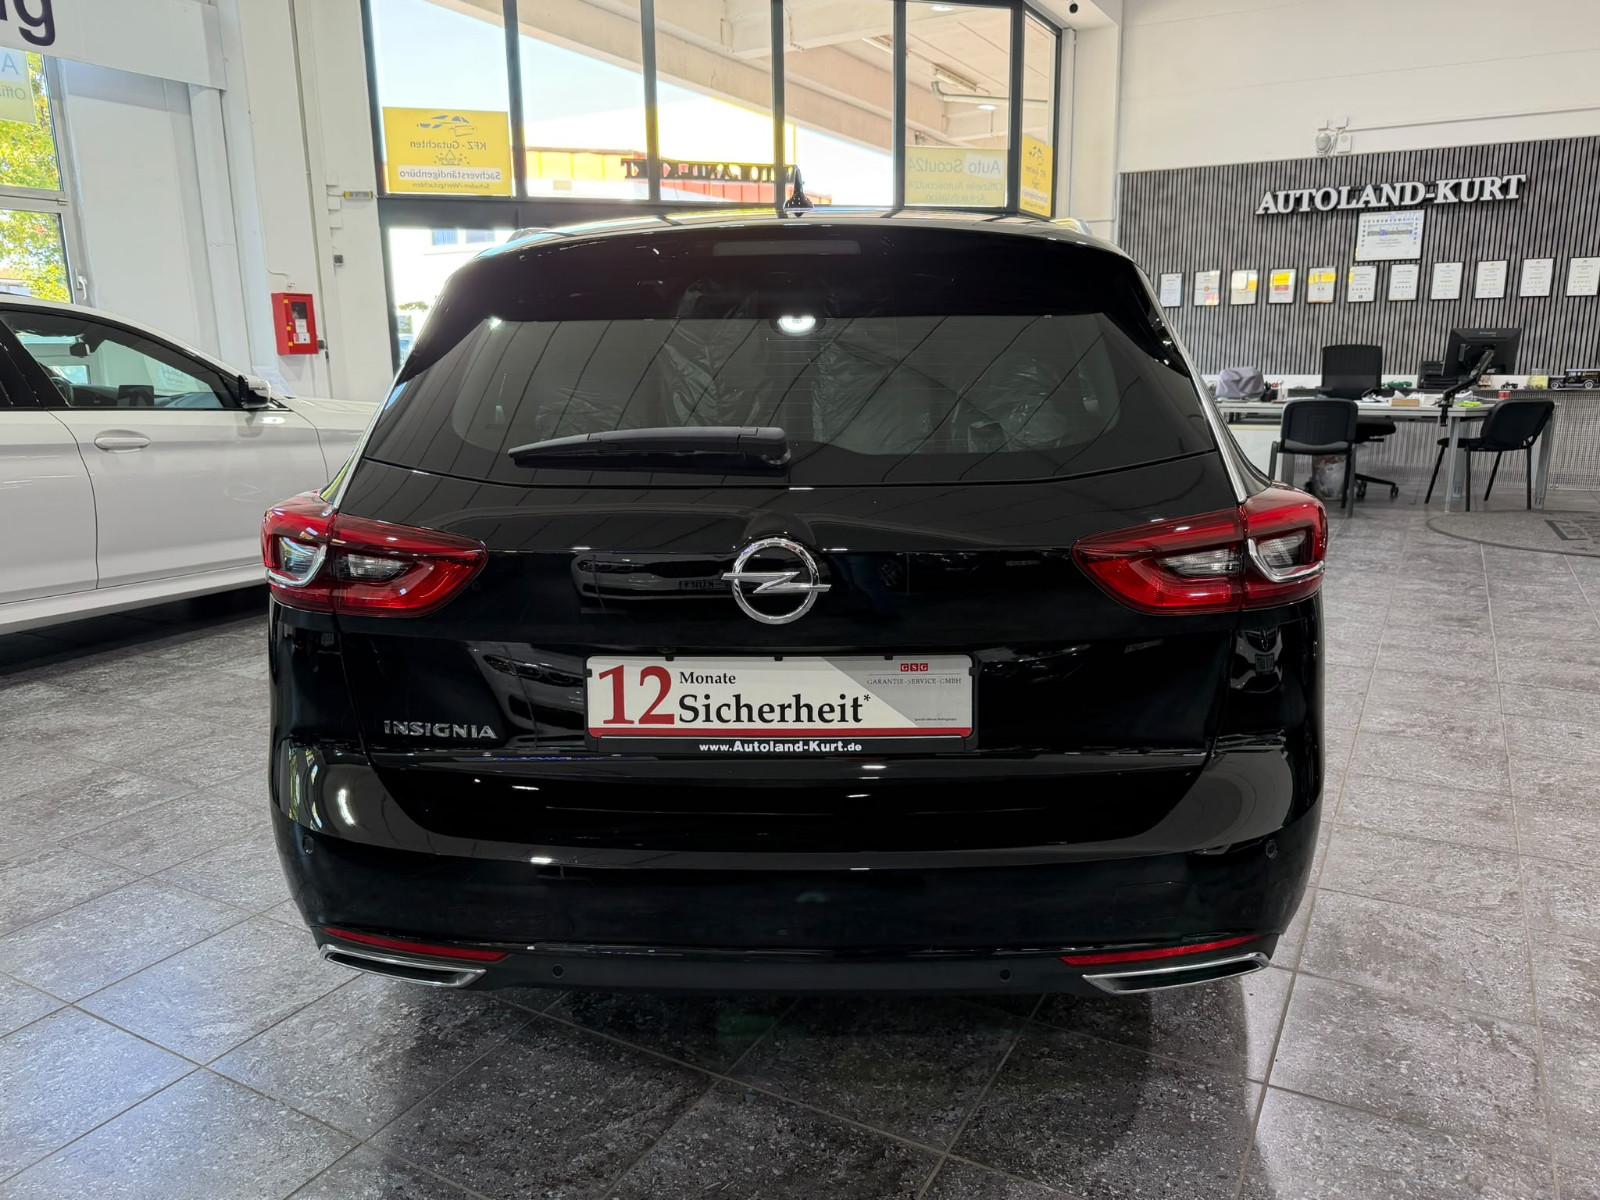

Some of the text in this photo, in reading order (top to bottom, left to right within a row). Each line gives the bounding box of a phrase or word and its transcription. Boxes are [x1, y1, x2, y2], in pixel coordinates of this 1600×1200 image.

[0, 0, 55, 46] g
[1256, 174, 1526, 215] AUTOLAND-KURT
[900, 663, 928, 672] GSG
[679, 671, 736, 684] Monate
[599, 664, 675, 725] 12
[384, 720, 498, 739] INSIGNIA
[699, 741, 863, 752] www.Autoland-Kurt.de
